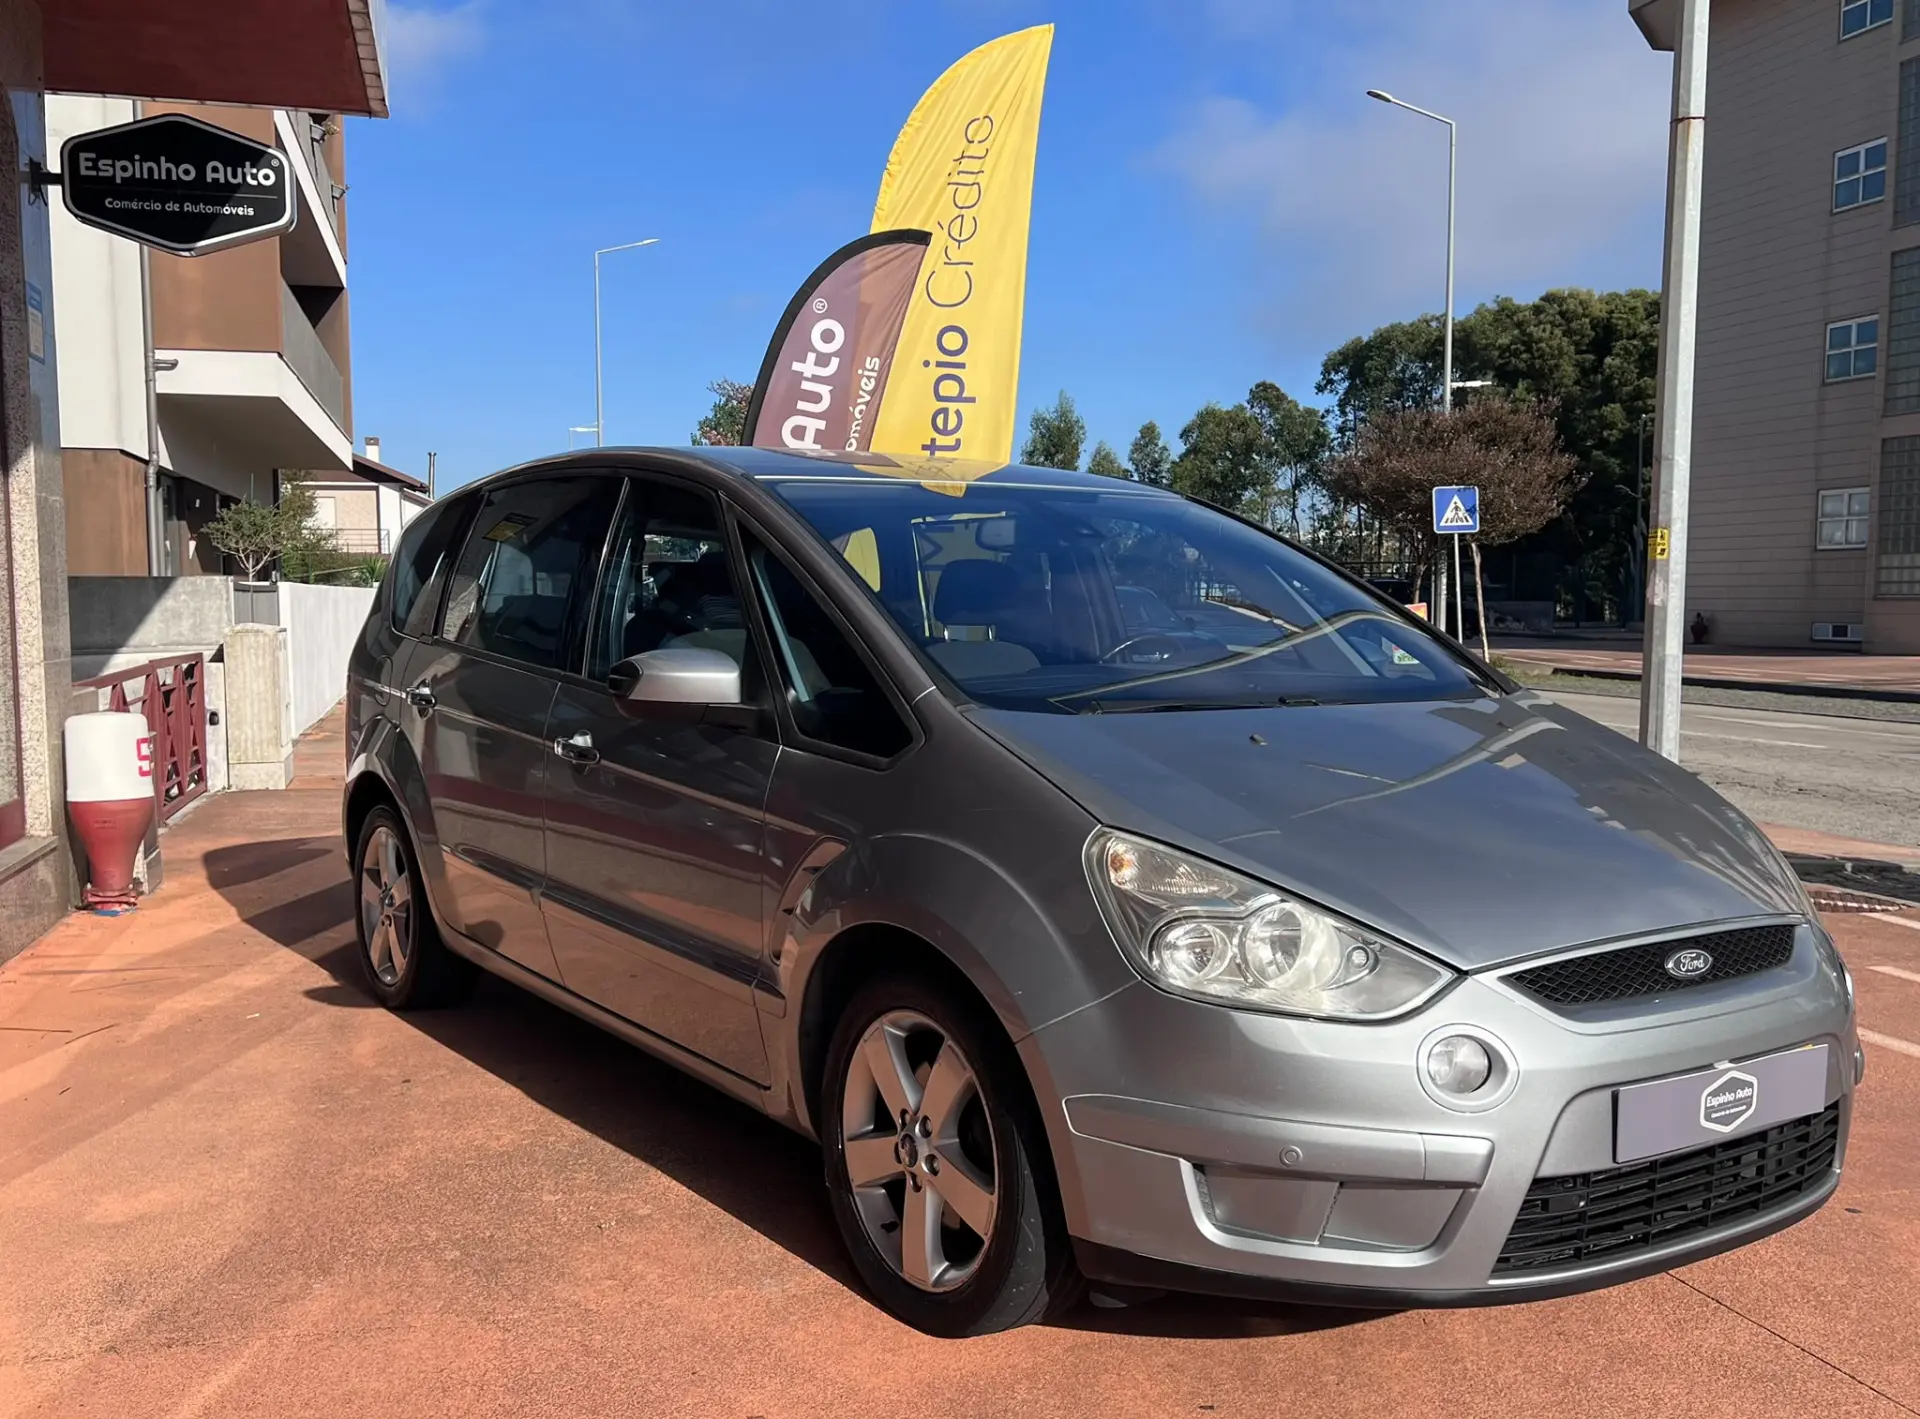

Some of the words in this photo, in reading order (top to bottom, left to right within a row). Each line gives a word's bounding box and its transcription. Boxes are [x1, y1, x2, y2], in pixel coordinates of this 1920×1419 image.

[78, 152, 196, 184] Espinho
[105, 197, 162, 211] Comércio
[165, 199, 180, 211] de
[184, 202, 254, 216] Automóveis
[925, 114, 994, 308] Crédito
[1680, 953, 1705, 971] Ford
[1706, 1091, 1735, 1107] Espinho
[1736, 1086, 1753, 1099] Auto
